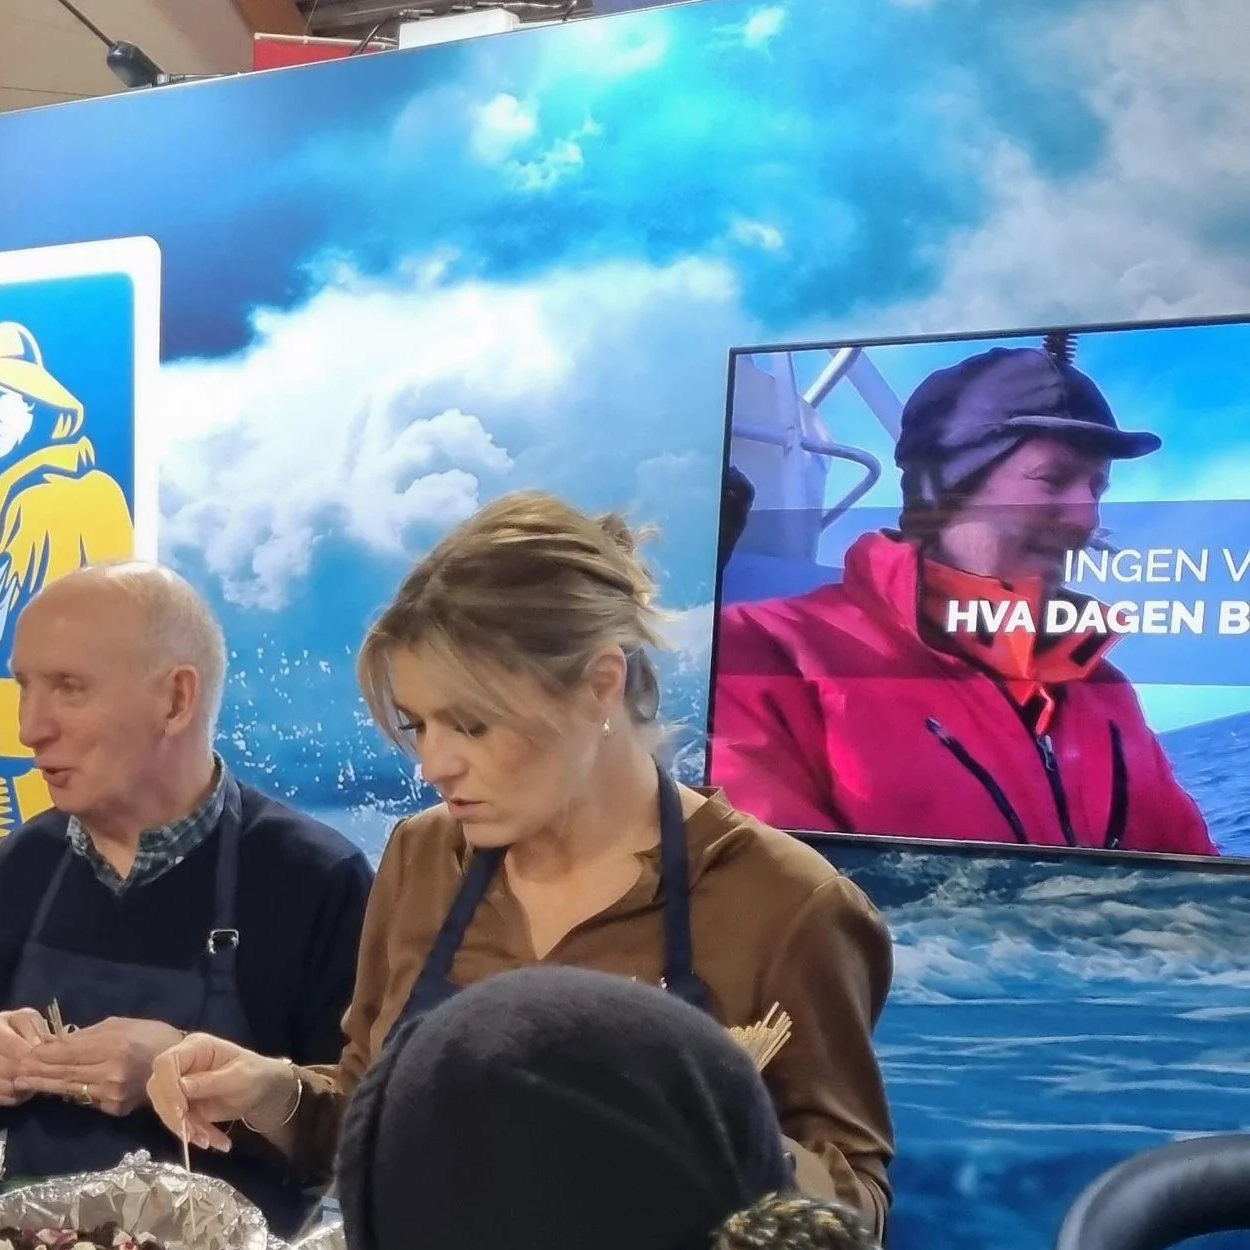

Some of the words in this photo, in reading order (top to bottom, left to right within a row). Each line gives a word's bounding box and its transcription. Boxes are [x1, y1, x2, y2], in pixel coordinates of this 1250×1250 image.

[1064, 548, 1209, 583] INGEN
[946, 600, 1036, 634] HVA
[1046, 600, 1205, 635] DAGEN
